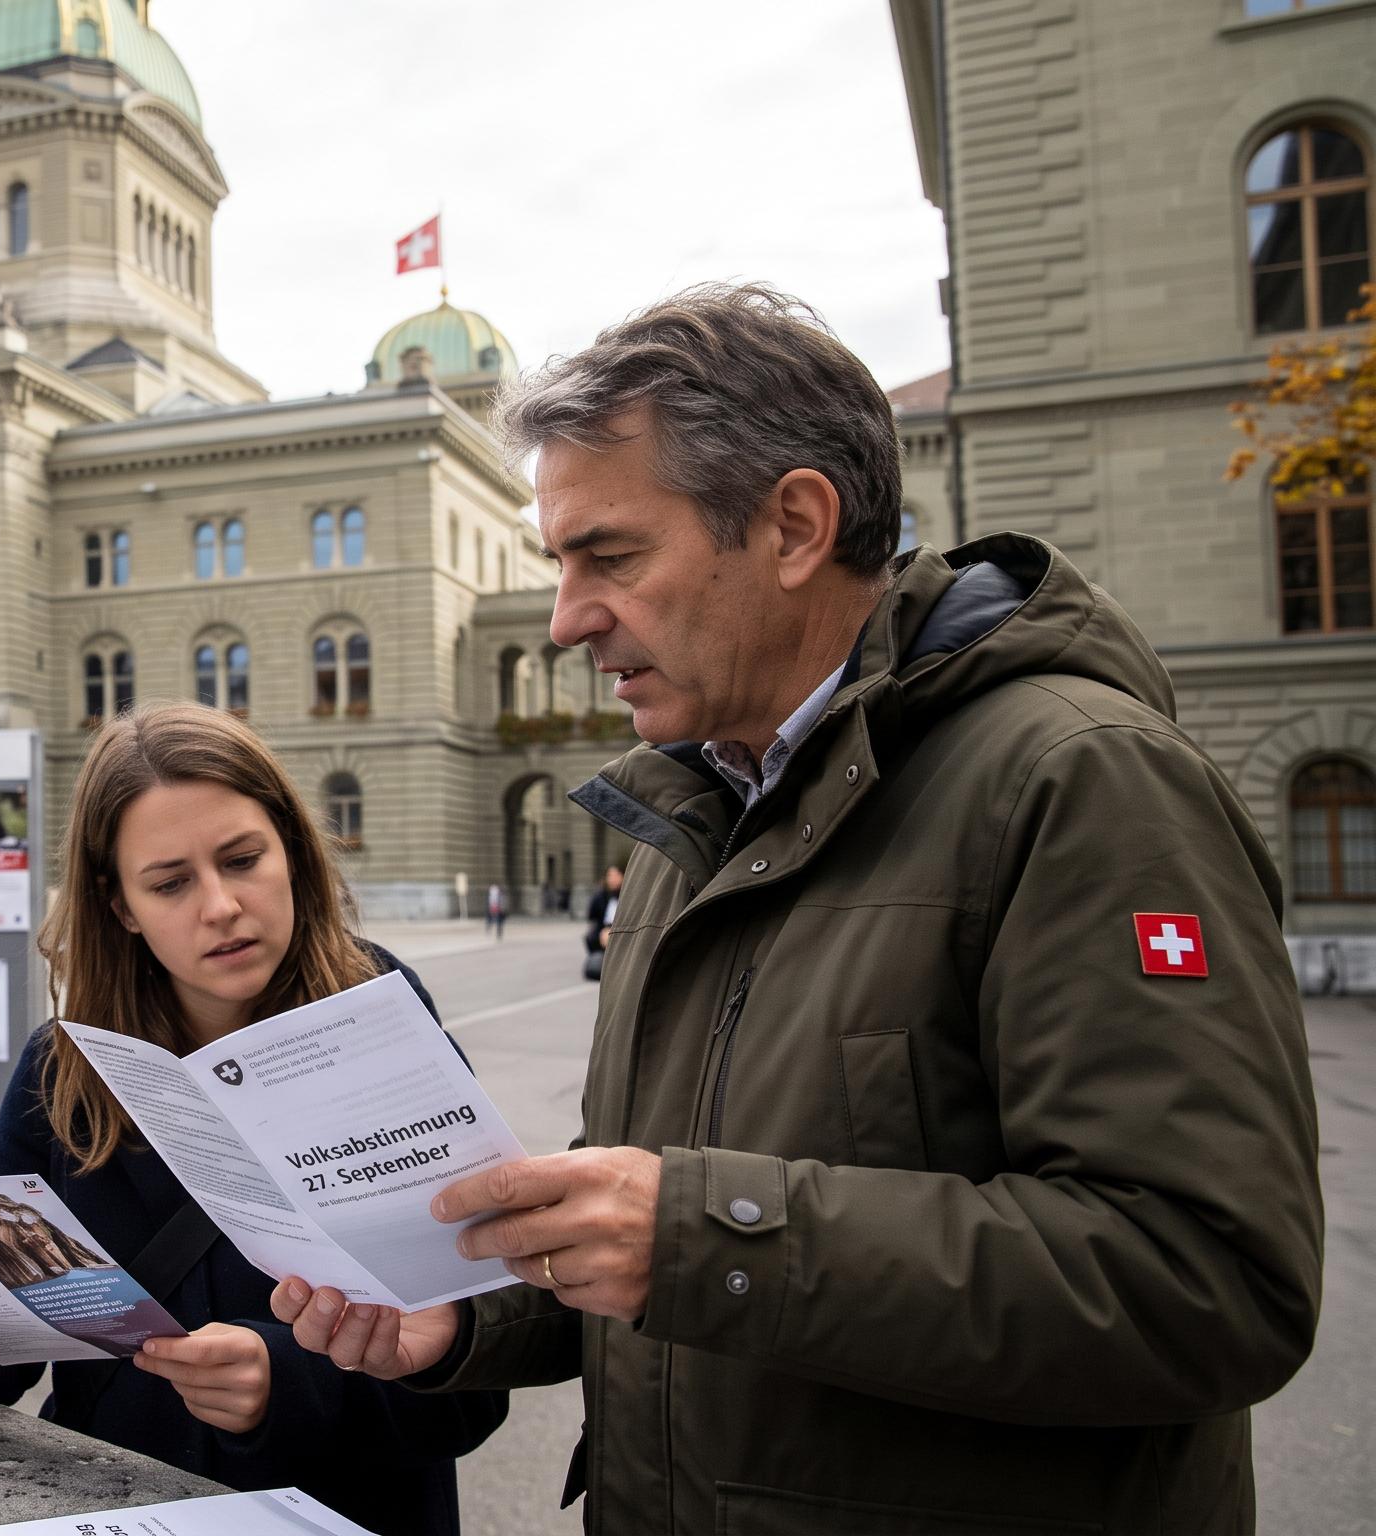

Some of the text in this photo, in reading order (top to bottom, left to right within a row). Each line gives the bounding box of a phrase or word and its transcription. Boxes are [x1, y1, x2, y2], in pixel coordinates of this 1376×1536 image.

[285, 1104, 477, 1169] Volksabstimmung
[302, 1173, 336, 1193] 27.
[336, 1142, 451, 1184] September
